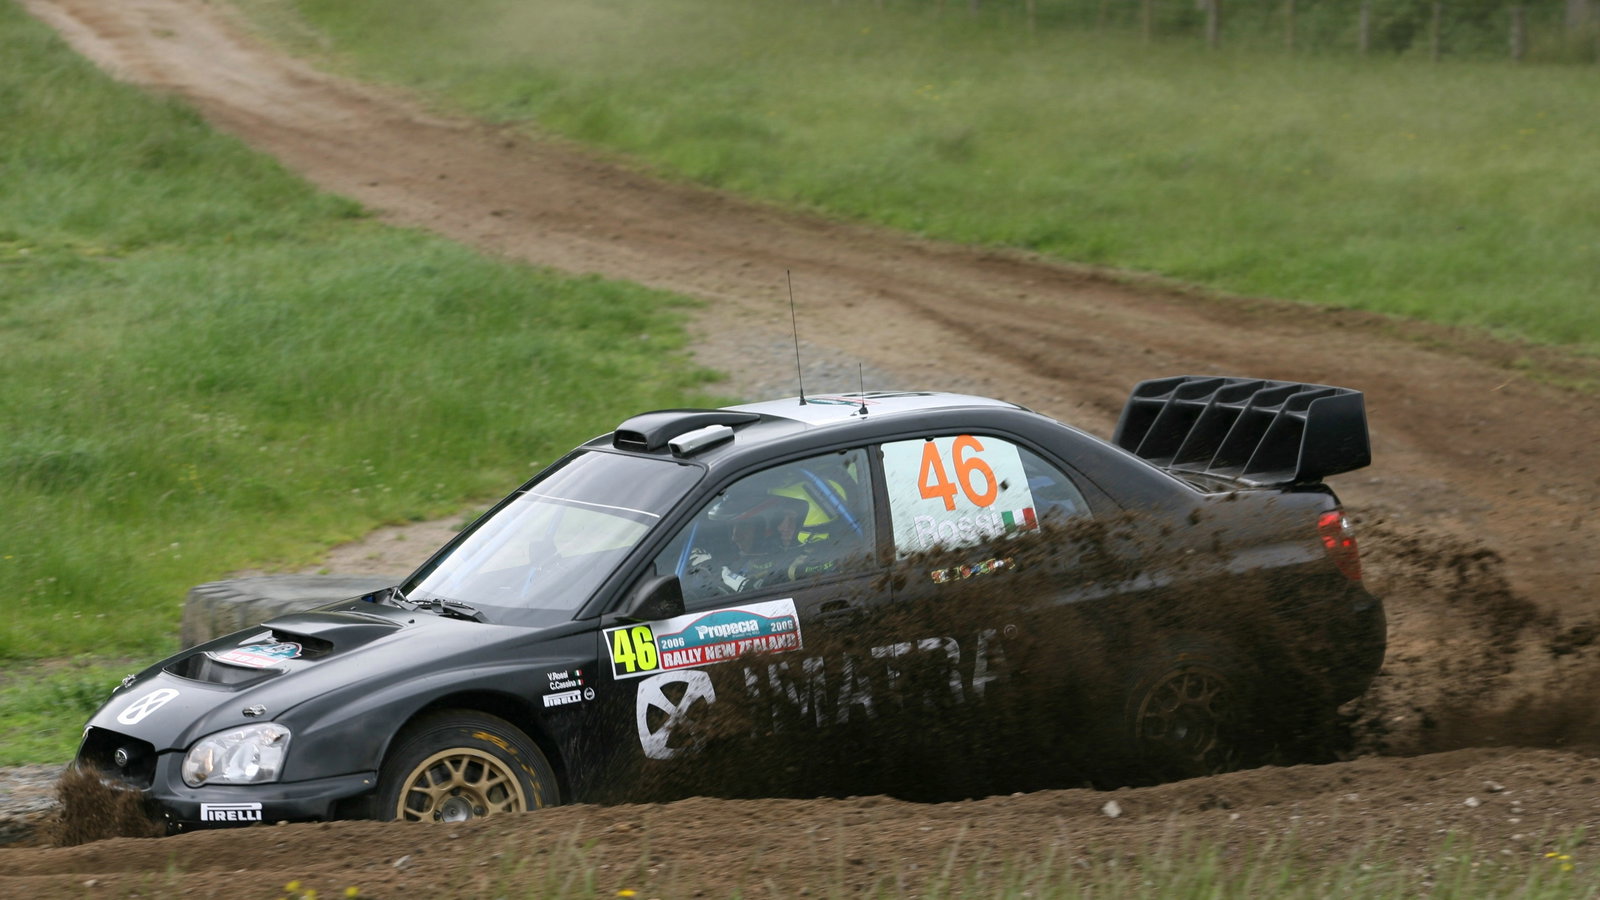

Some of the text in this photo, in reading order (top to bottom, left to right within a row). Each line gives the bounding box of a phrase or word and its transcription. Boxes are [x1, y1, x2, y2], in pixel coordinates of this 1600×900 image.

[917, 434, 998, 511] 46
[914, 506, 1001, 547] Rossi
[612, 625, 657, 672] 46
[661, 637, 685, 649] 2006
[695, 619, 759, 640] Propecia
[770, 619, 794, 632] 2006
[663, 633, 797, 667] RALLY NEW ZEALAND
[543, 690, 582, 707] PIRELLI
[201, 802, 262, 821] PIRELLI
